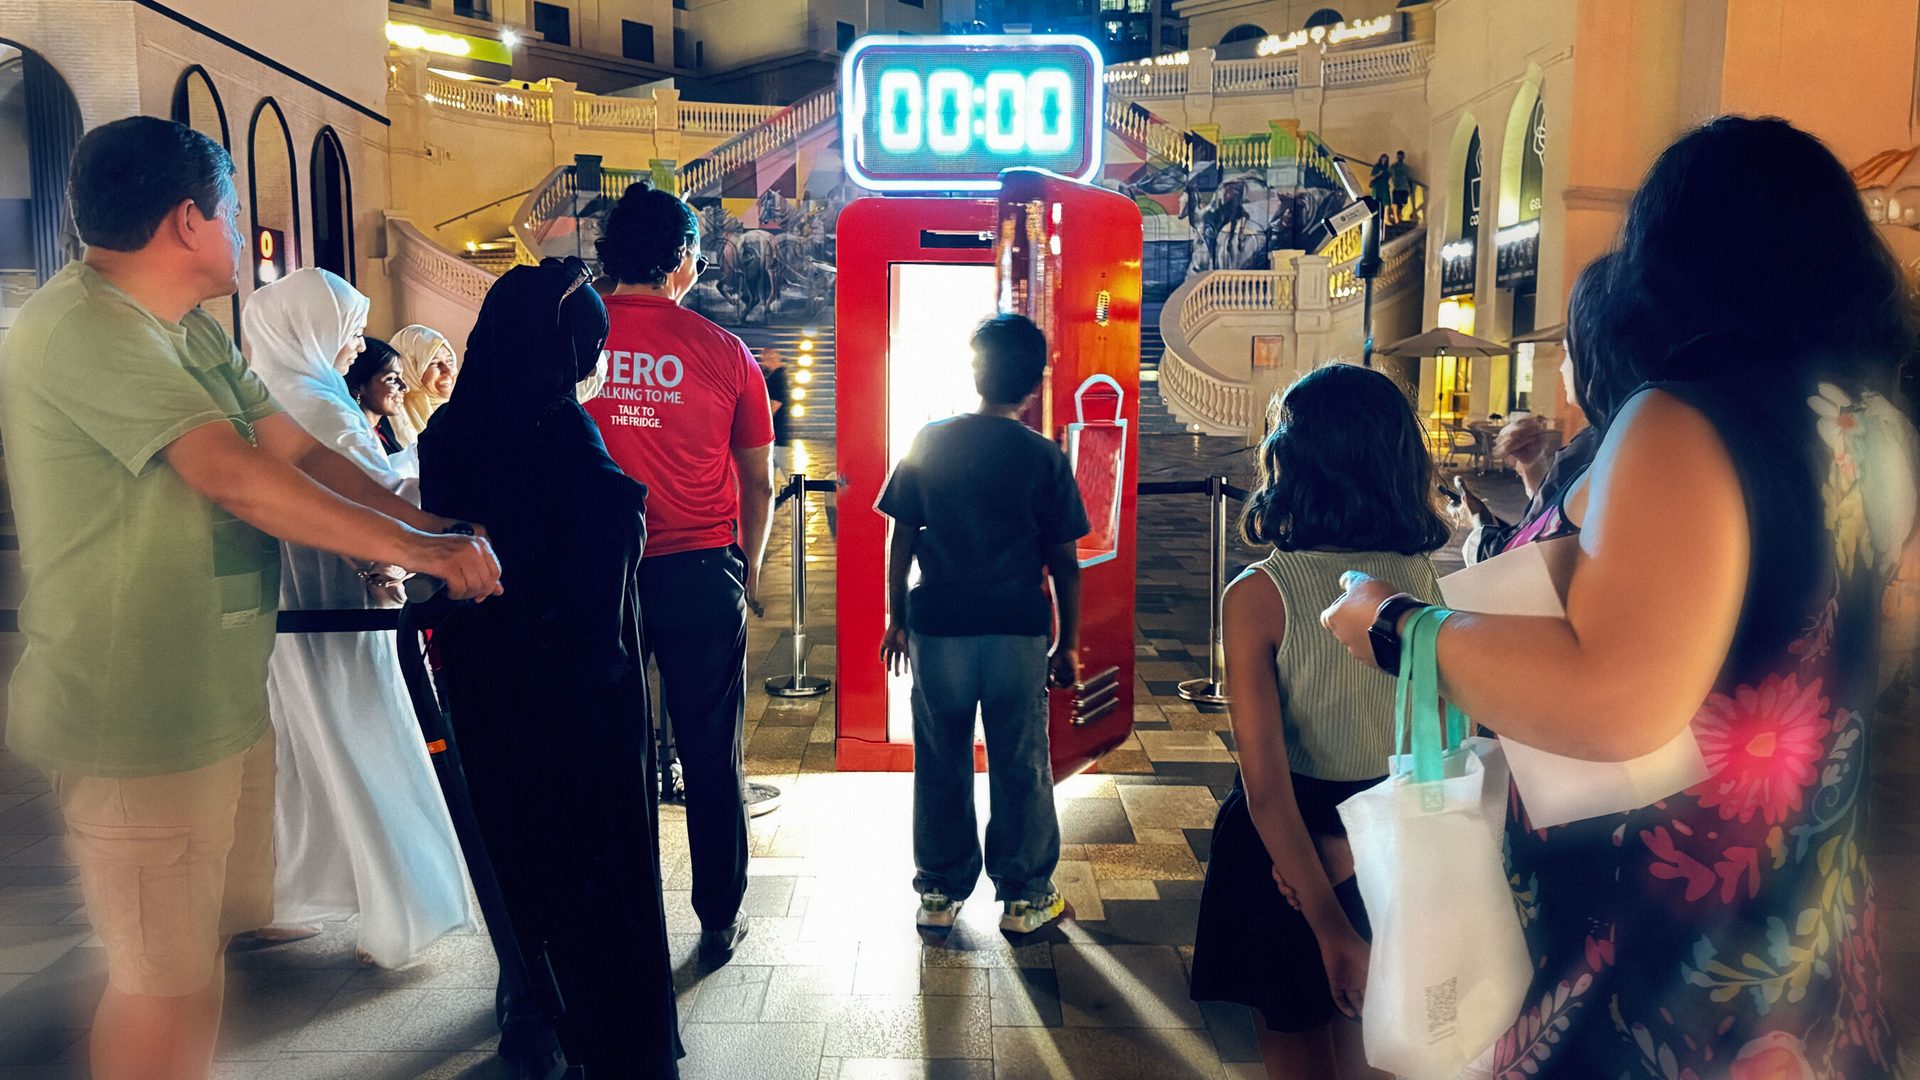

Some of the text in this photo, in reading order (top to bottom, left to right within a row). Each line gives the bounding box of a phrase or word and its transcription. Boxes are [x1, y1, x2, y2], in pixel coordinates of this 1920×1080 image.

[880, 69, 1073, 154] 00:00
[596, 386, 684, 404] ALKING TO ME.
[618, 405, 655, 417] TALK TO
[610, 415, 663, 428] THE FRIDGE.
